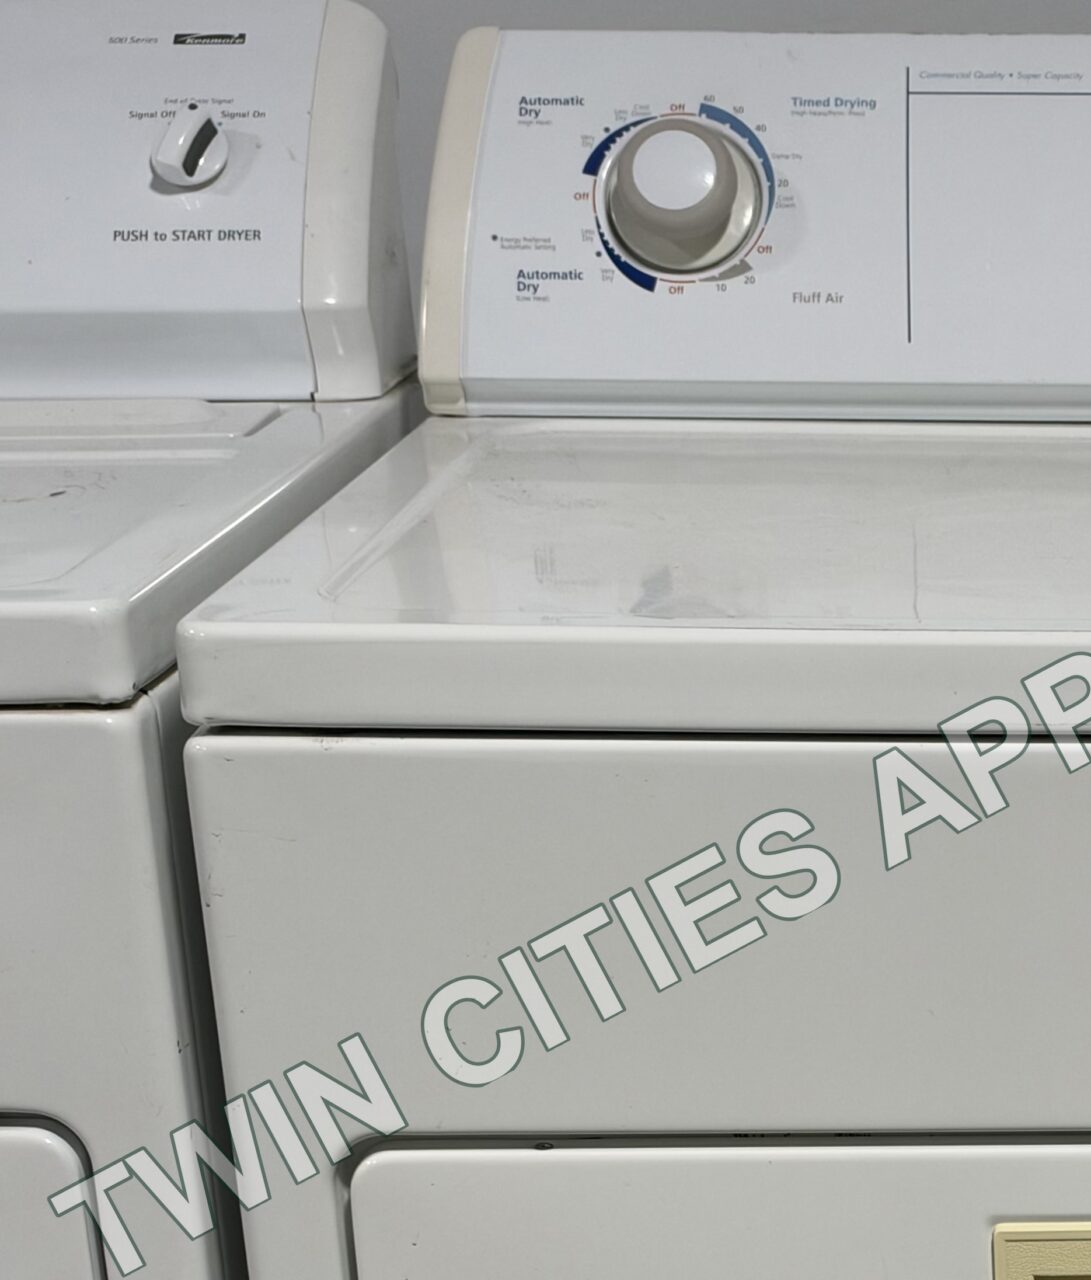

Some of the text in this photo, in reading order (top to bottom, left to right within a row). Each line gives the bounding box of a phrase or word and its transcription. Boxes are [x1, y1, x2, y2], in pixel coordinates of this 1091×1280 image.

[128, 36, 158, 44] Series
[178, 34, 246, 45] Kenmore
[919, 70, 1083, 82] Commercial Quality Super Capacity
[518, 96, 584, 107] Automatic
[703, 95, 715, 103] 60
[791, 97, 877, 110] Timed Drying
[670, 104, 685, 112] Off
[733, 106, 744, 114] 50
[128, 110, 176, 120] Signal Off
[220, 110, 266, 120] Signal On
[518, 107, 541, 119] Dry
[755, 124, 767, 133] 40
[777, 179, 789, 188] 20
[573, 192, 589, 200] Off
[113, 230, 261, 242] PUSH to START DRYER
[757, 245, 772, 254] Off
[516, 269, 584, 281] Automatic
[744, 276, 756, 284] 20
[517, 281, 539, 294] Dry
[669, 286, 684, 295] Off
[716, 283, 727, 292] 10
[792, 292, 844, 304] Fluff Air
